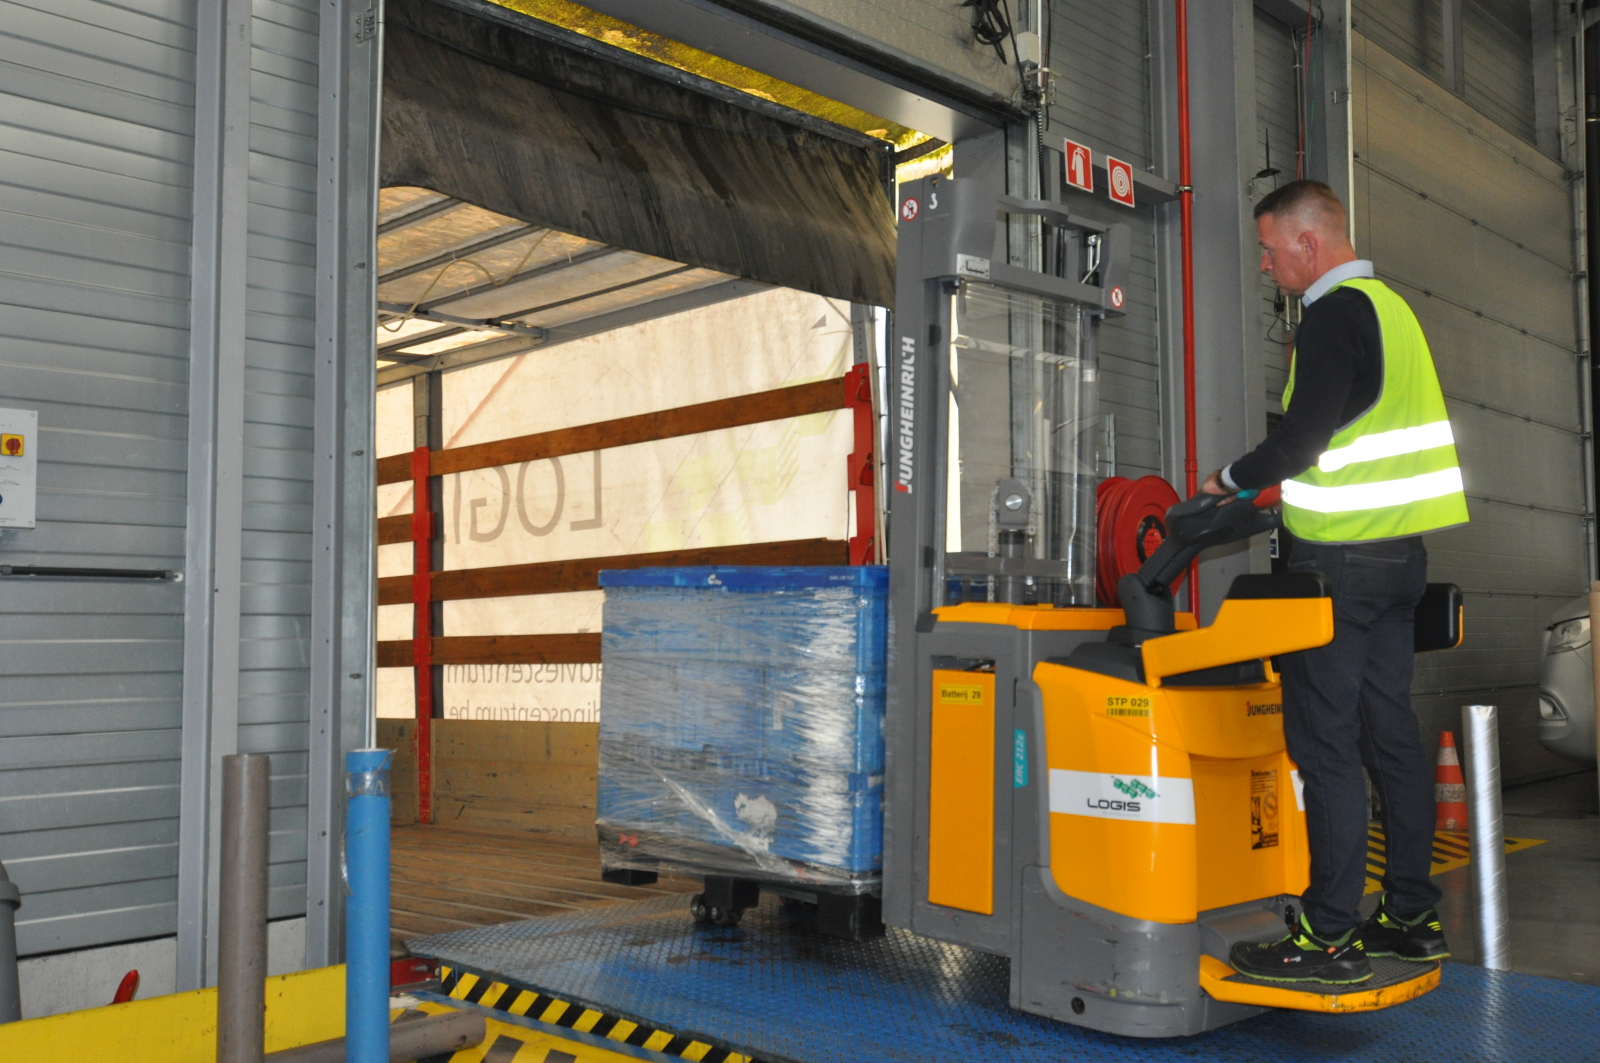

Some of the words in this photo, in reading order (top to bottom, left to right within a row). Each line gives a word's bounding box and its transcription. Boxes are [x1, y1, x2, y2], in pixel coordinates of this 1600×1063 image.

[895, 336, 915, 494] JUNGHEINRICH
[941, 689, 969, 701] Batterij
[972, 690, 981, 700] 29
[1107, 697, 1128, 707] STP
[1130, 698, 1150, 708] 029
[1246, 700, 1283, 717] JUNGHEIN
[1087, 798, 1141, 812] LOGIS
